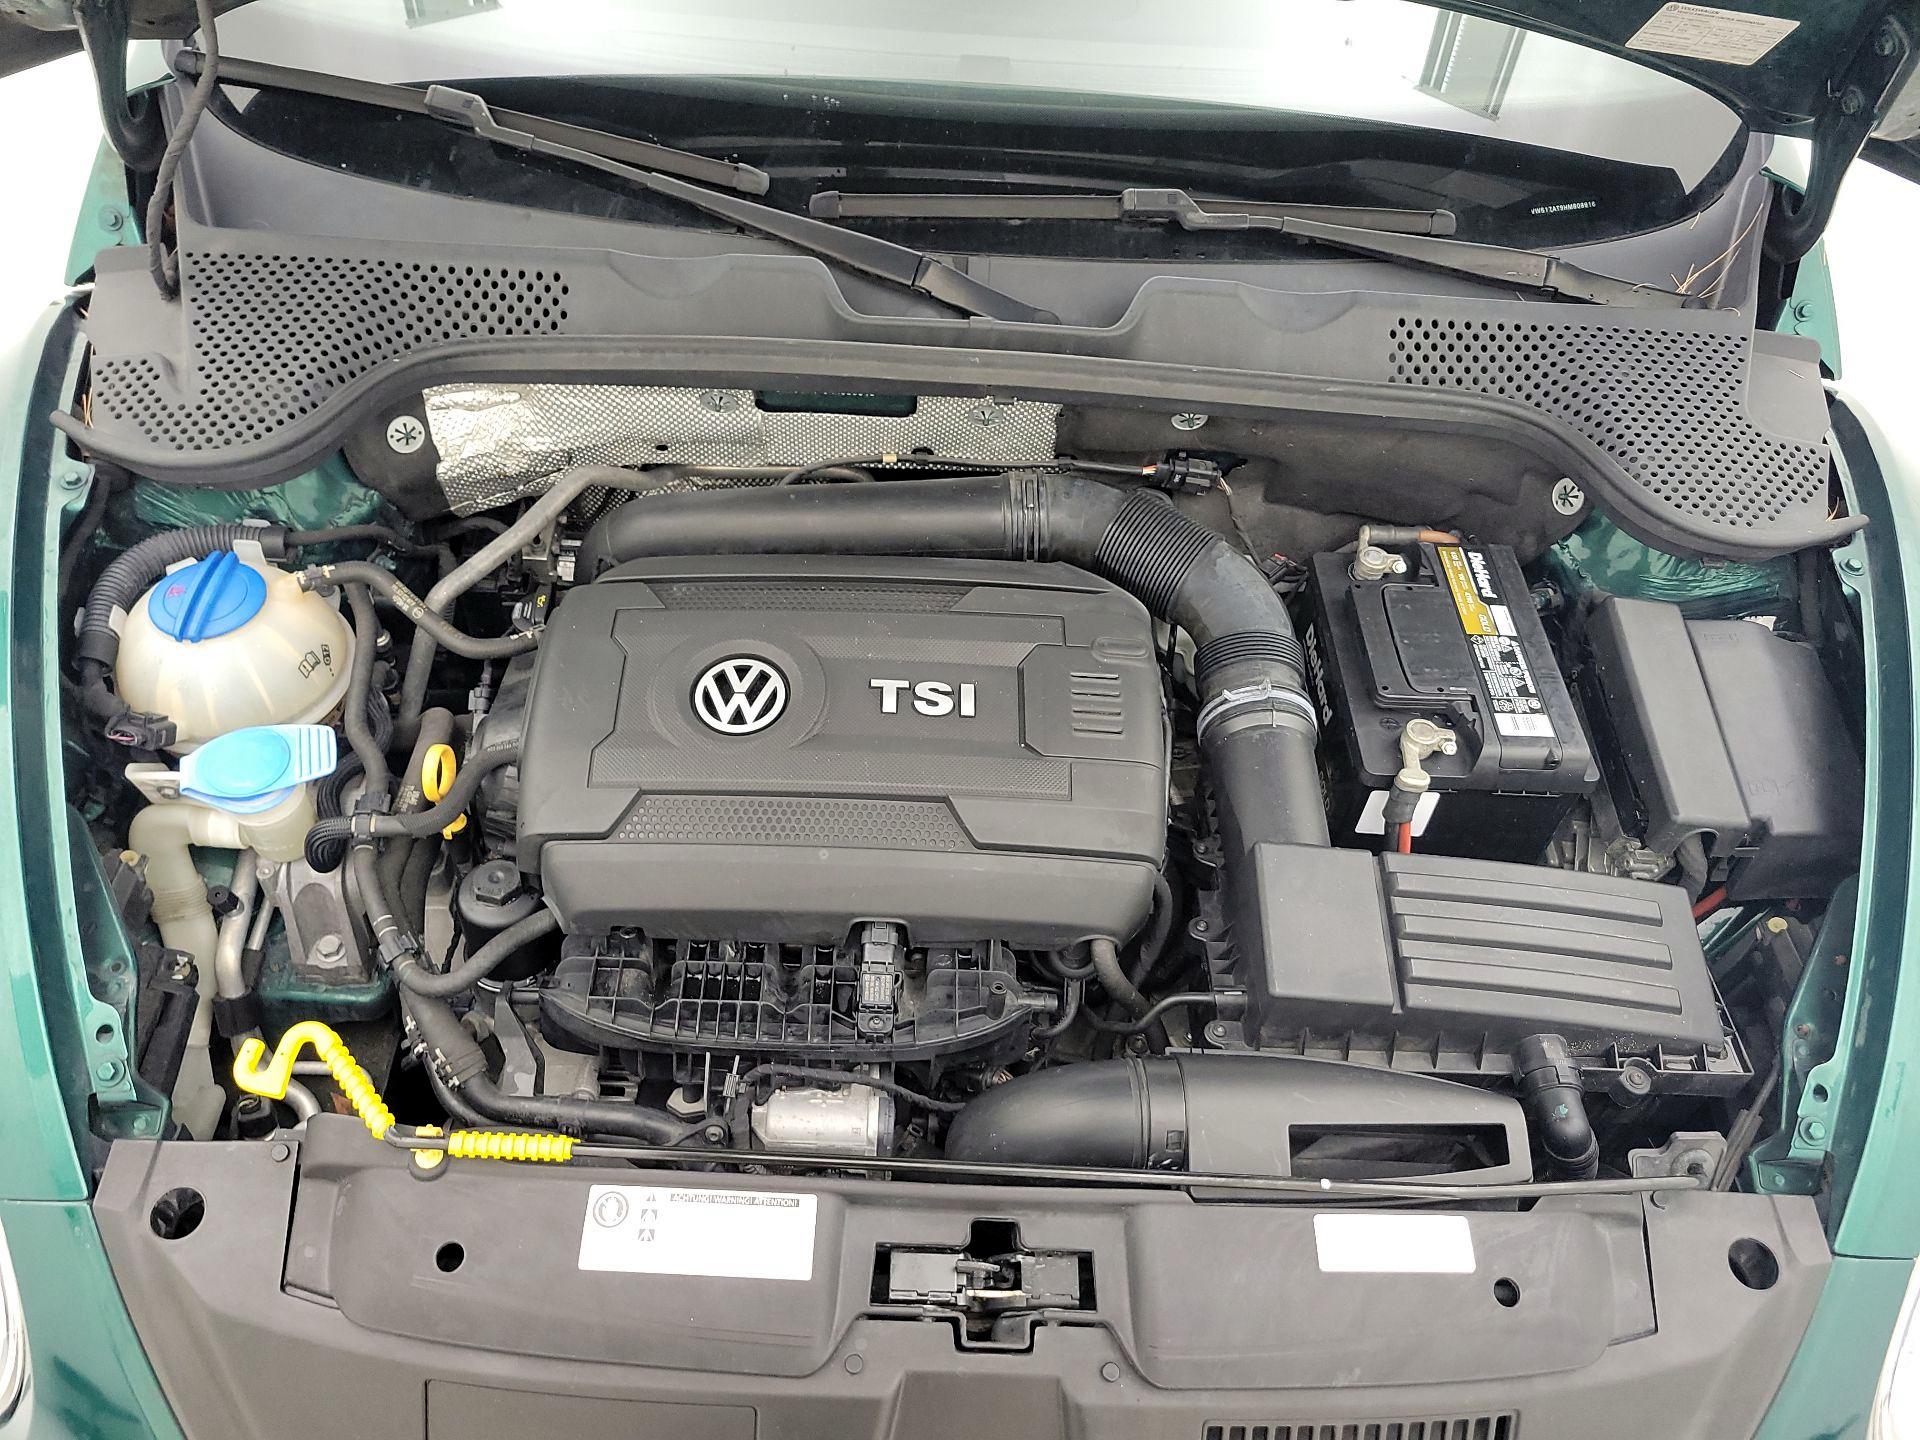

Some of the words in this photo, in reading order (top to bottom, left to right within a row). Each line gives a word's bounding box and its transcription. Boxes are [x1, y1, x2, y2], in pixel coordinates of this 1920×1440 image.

[1467, 551, 1498, 599] DieHard
[1478, 613, 1492, 633] GOLD
[1305, 621, 1334, 727] DieHard
[869, 677, 977, 718] TSI
